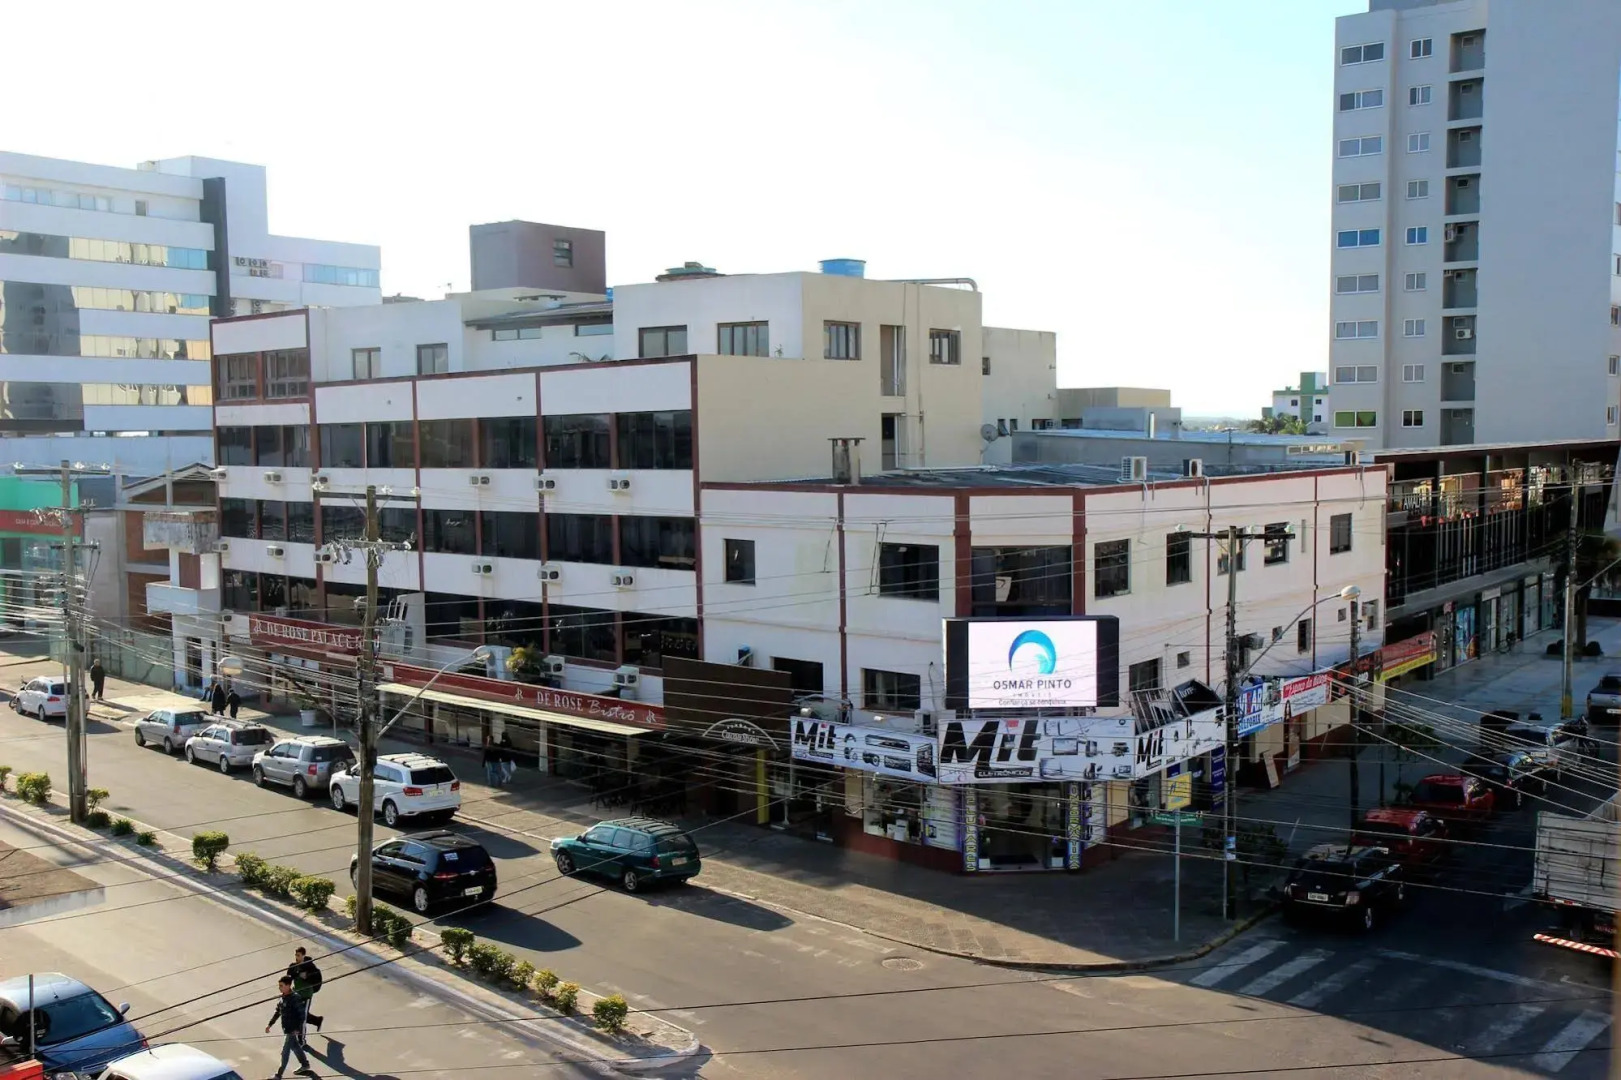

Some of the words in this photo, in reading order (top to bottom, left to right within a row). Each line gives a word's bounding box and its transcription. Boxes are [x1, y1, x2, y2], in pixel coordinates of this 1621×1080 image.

[282, 624, 308, 641] ROSE
[311, 628, 354, 649] PALACE
[994, 680, 1033, 691] OSMAR
[1037, 679, 1072, 690] PINTO
[536, 690, 551, 706] DE
[554, 694, 583, 712] ROSE
[587, 699, 635, 722] Bistrô
